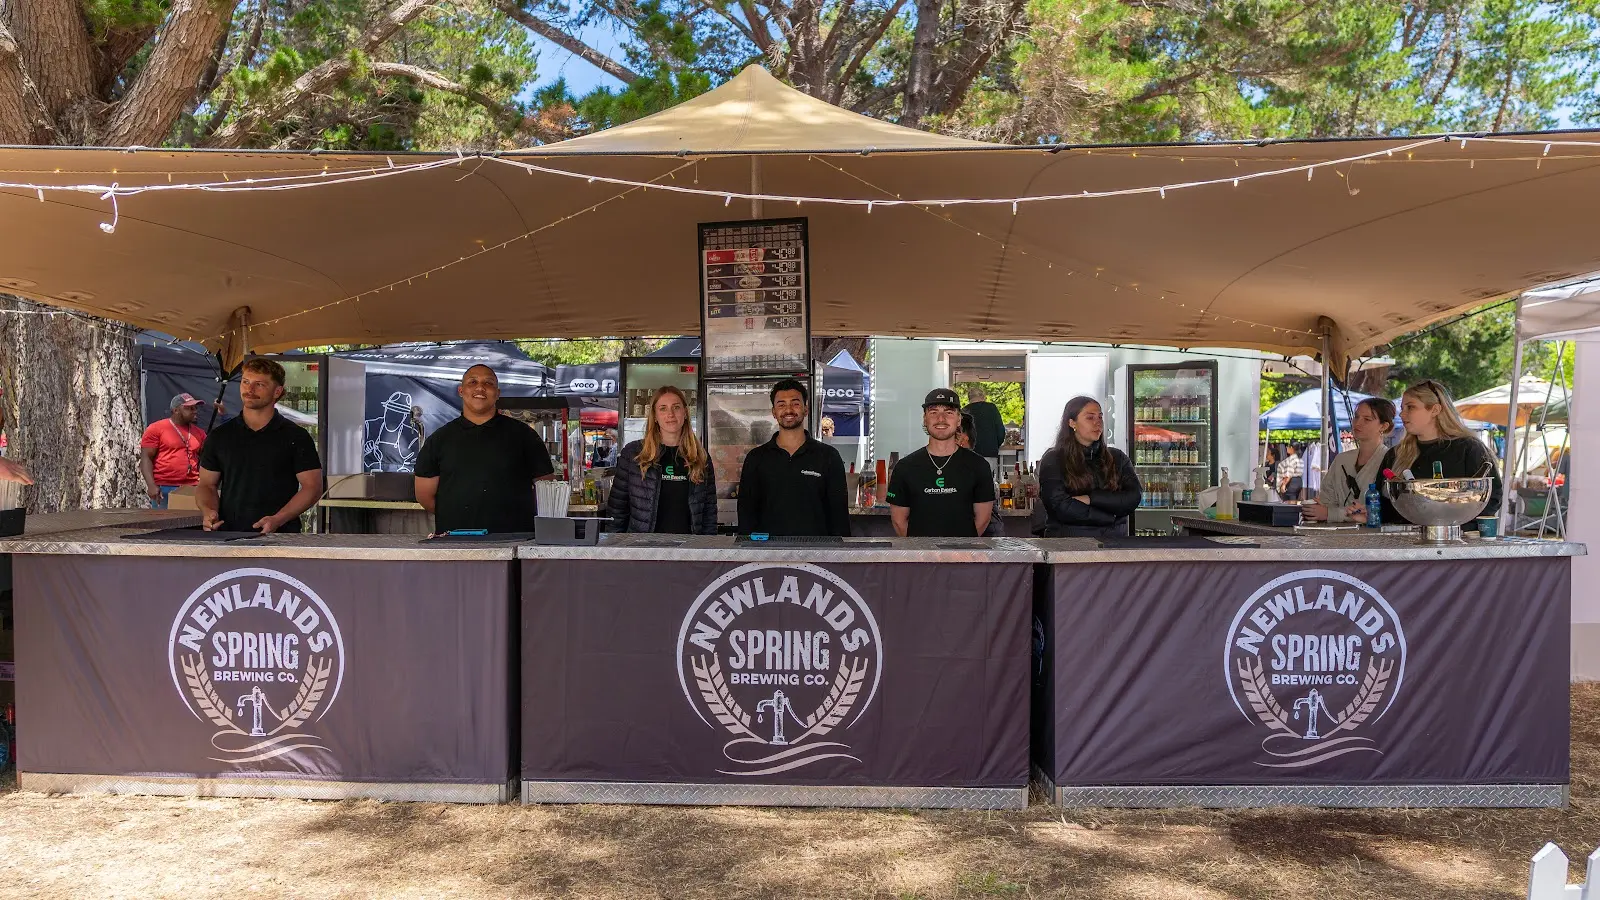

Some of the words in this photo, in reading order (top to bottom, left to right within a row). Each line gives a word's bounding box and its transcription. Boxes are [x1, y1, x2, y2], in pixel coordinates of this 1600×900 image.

[178, 582, 333, 653] NEWLANDS
[689, 575, 870, 653] NEWLANDS
[1236, 584, 1396, 656] NEWLANDS
[212, 631, 299, 670] SPRING
[729, 629, 830, 671] SPRING
[1271, 634, 1363, 672] SPRING
[213, 670, 274, 682] BREWING
[277, 671, 299, 684] CO.
[730, 673, 800, 685] BREWING
[803, 673, 829, 686] CO.
[1271, 674, 1333, 685] BREWING
[1335, 674, 1359, 685] CO.
